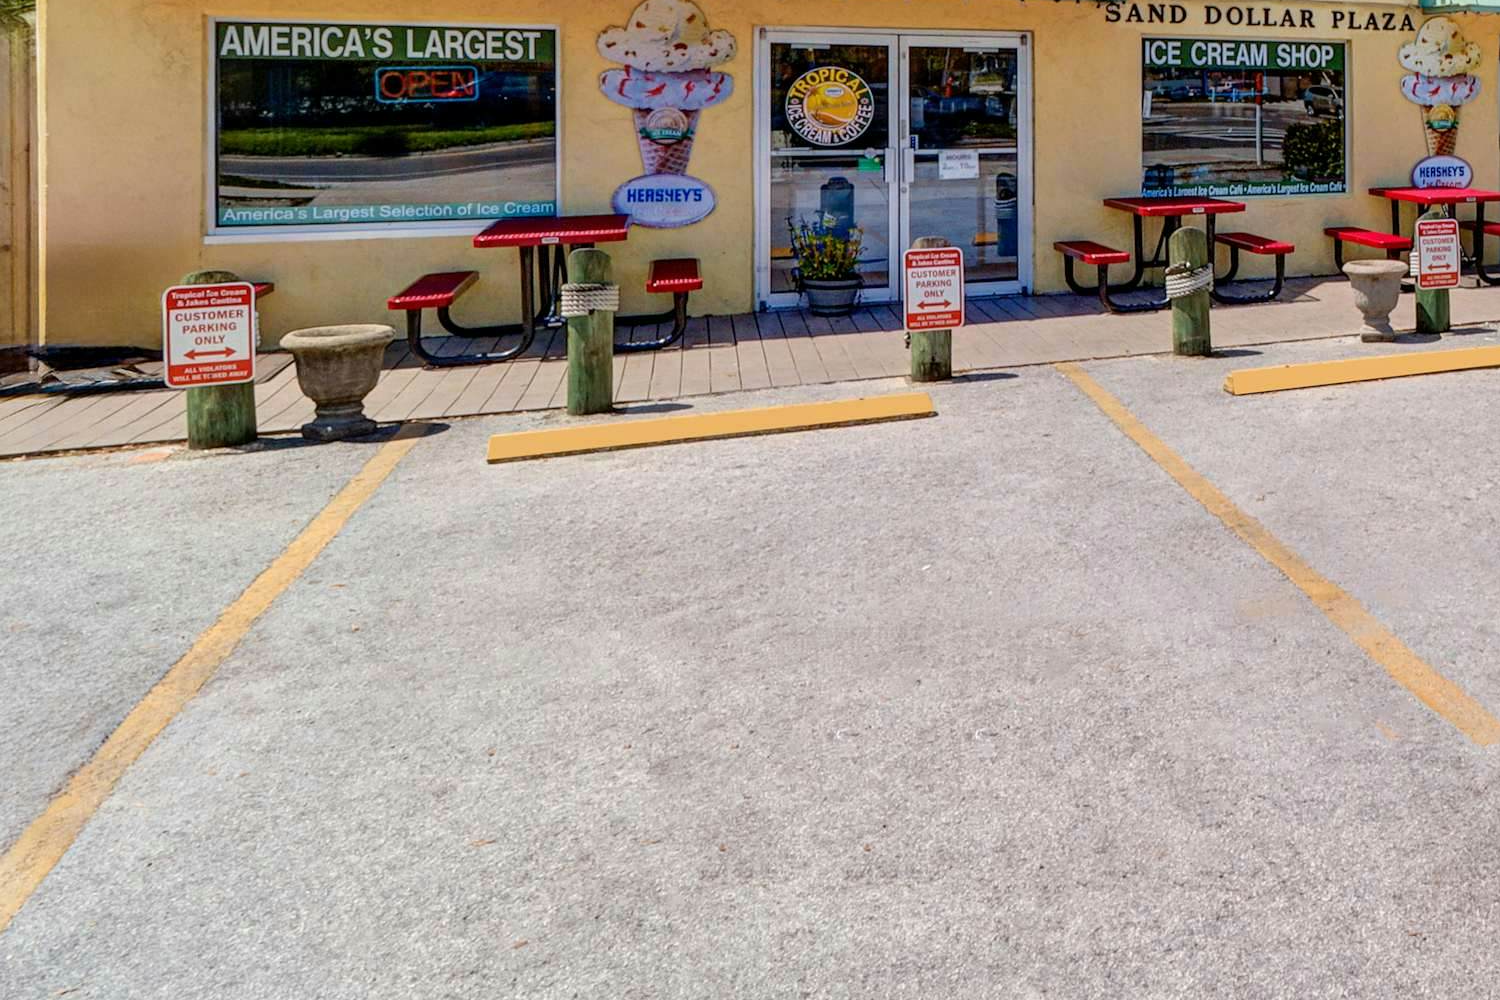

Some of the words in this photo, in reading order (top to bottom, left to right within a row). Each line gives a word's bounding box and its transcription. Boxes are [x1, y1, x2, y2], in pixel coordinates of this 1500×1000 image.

[1105, 3, 1188, 24] SAND
[1204, 5, 1316, 28] DOLLAR
[1331, 10, 1416, 32] PLAZA
[220, 25, 393, 59] AMERICA'S
[407, 30, 541, 60] LARGEST
[1145, 40, 1182, 65] ICE
[1191, 42, 1268, 67] CREAM
[1277, 44, 1335, 68] SHOP
[380, 71, 474, 98] OPEN
[789, 68, 868, 99] TROPICAL
[787, 104, 804, 121] ICE
[839, 104, 872, 141] COFFEE
[794, 118, 832, 143] CREAM
[1420, 166, 1465, 177] HERSHEY'S
[627, 188, 703, 202] HERSHEY'S
[222, 206, 308, 222] America's
[313, 204, 370, 221] Largest
[380, 204, 452, 218] Selection
[457, 203, 472, 215] of
[477, 202, 499, 215] Ice
[504, 201, 554, 214] Cream
[1423, 237, 1454, 245] CUSTOMER
[911, 269, 957, 279] CUSTOMER
[916, 279, 952, 289] PARKING
[171, 291, 204, 299] Tropical
[924, 290, 944, 298] ONLY
[175, 309, 244, 322] CUSTOMER
[182, 322, 237, 334] PARKING
[194, 335, 225, 345] ONLY
